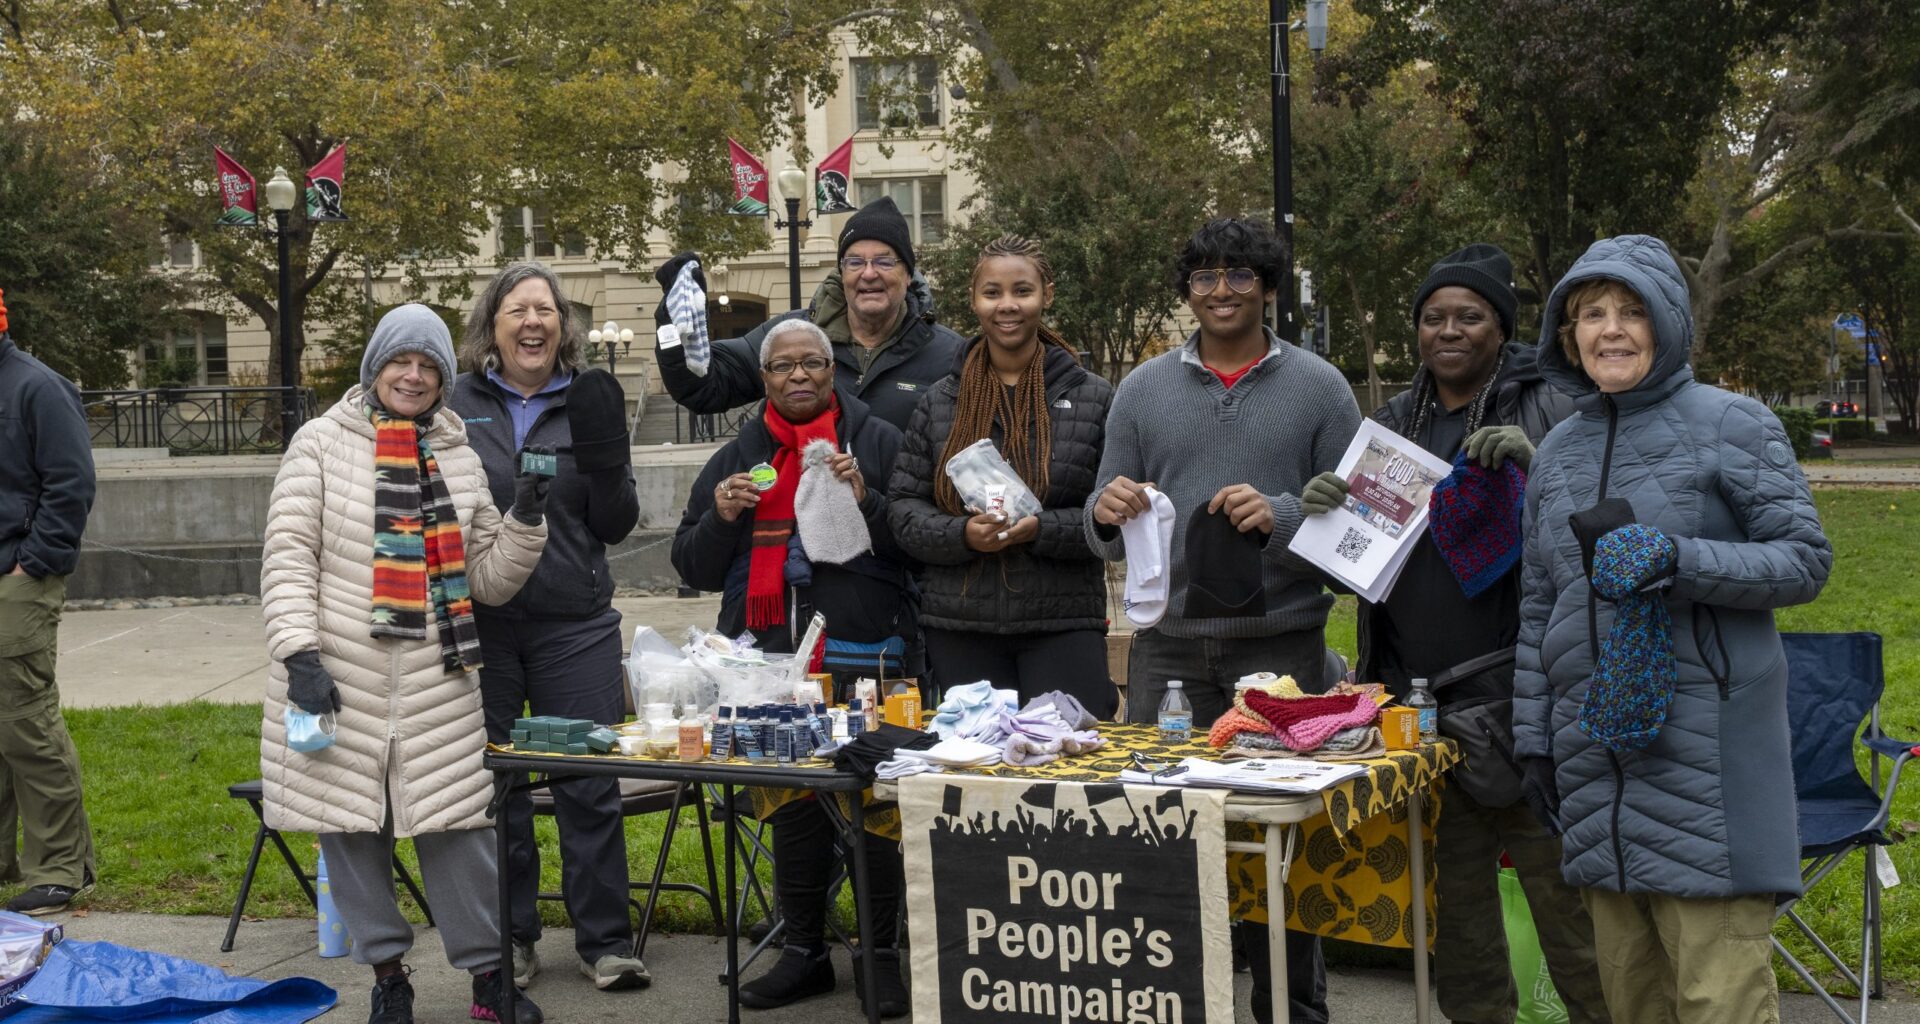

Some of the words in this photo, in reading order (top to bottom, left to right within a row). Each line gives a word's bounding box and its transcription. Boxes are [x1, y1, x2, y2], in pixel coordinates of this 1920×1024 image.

[1383, 454, 1415, 486] FOOD
[1007, 856, 1122, 910] Poor
[966, 908, 1174, 973] People's
[961, 967, 1182, 1024] Campaign
